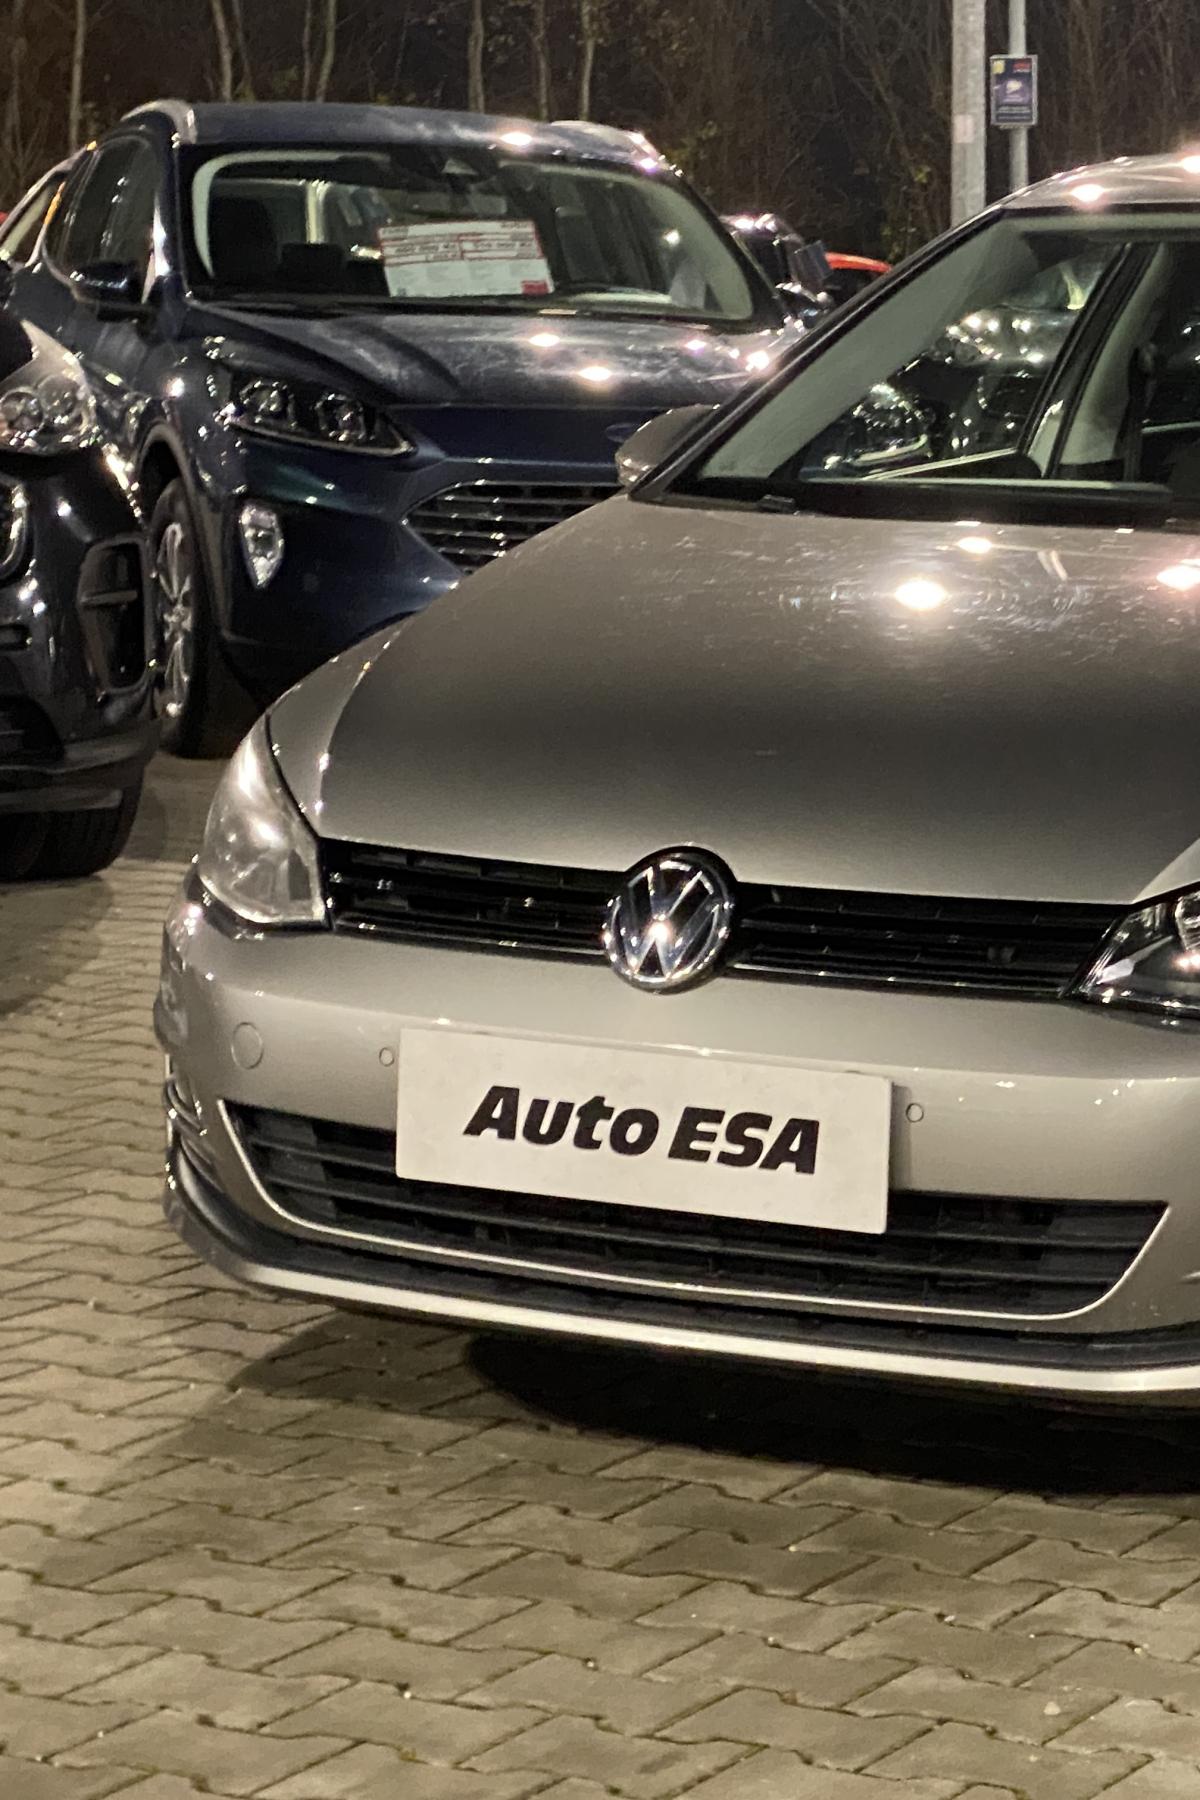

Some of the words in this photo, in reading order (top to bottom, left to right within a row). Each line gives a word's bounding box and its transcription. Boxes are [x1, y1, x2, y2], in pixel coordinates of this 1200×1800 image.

[606, 856, 728, 984] VW
[463, 1084, 660, 1156] Auto
[668, 1106, 820, 1175] ESA
